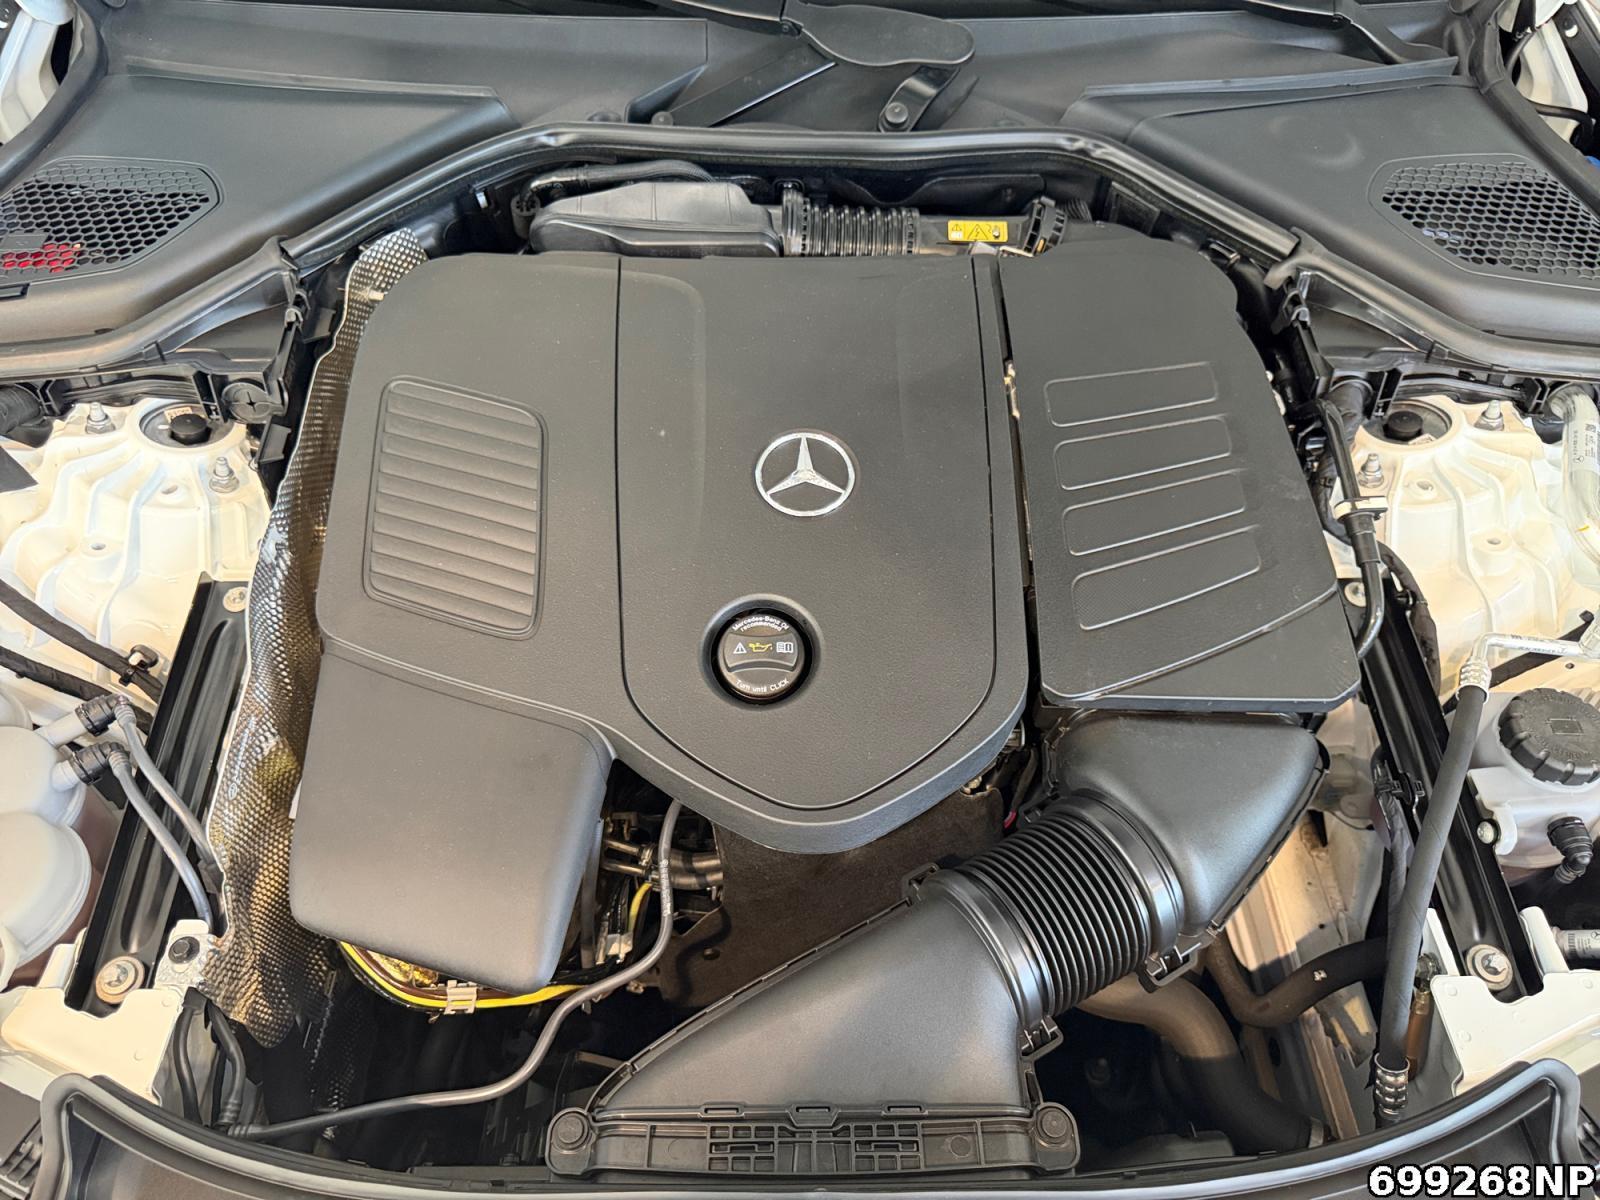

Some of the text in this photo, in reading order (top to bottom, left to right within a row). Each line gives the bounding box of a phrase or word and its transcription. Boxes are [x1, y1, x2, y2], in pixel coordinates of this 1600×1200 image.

[732, 616, 780, 630] Mercedes-Benz
[740, 622, 783, 632] recommended
[736, 679, 751, 690] Turn
[769, 678, 789, 691] CLICK
